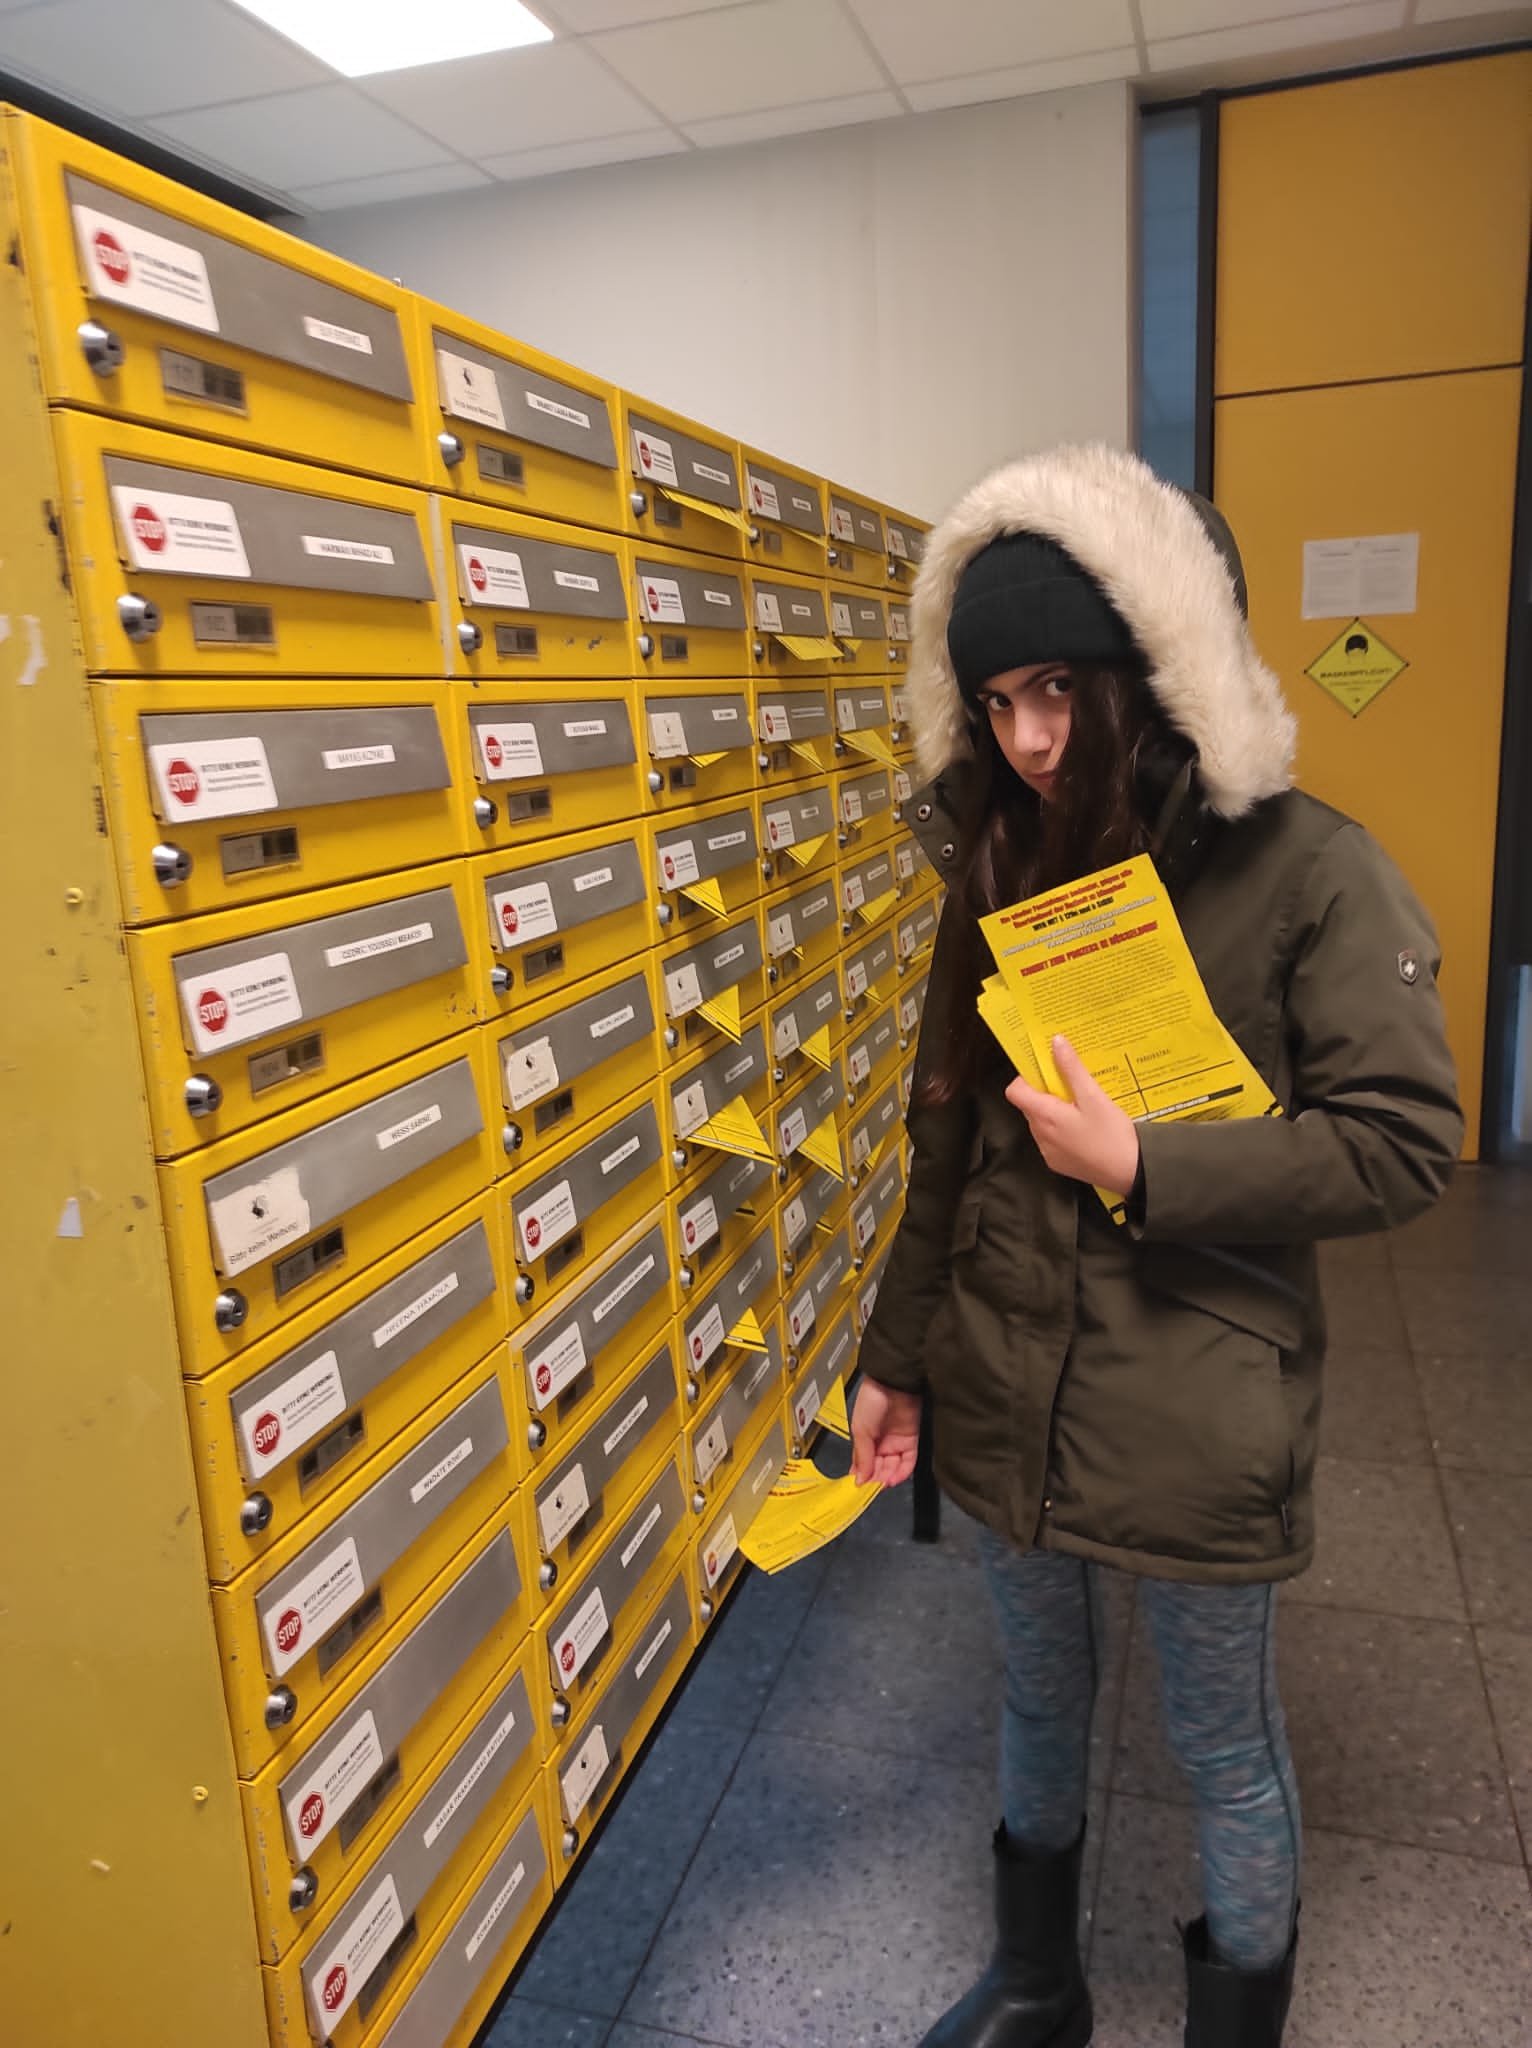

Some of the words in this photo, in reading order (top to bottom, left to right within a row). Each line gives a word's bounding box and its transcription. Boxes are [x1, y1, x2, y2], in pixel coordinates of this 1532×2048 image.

[169, 773, 198, 793] STOP
[200, 1001, 226, 1024] STOP
[255, 1421, 279, 1449] STOP
[279, 1616, 301, 1647] STOP
[301, 1800, 320, 1832] STOP
[325, 1971, 344, 2006] STOP
